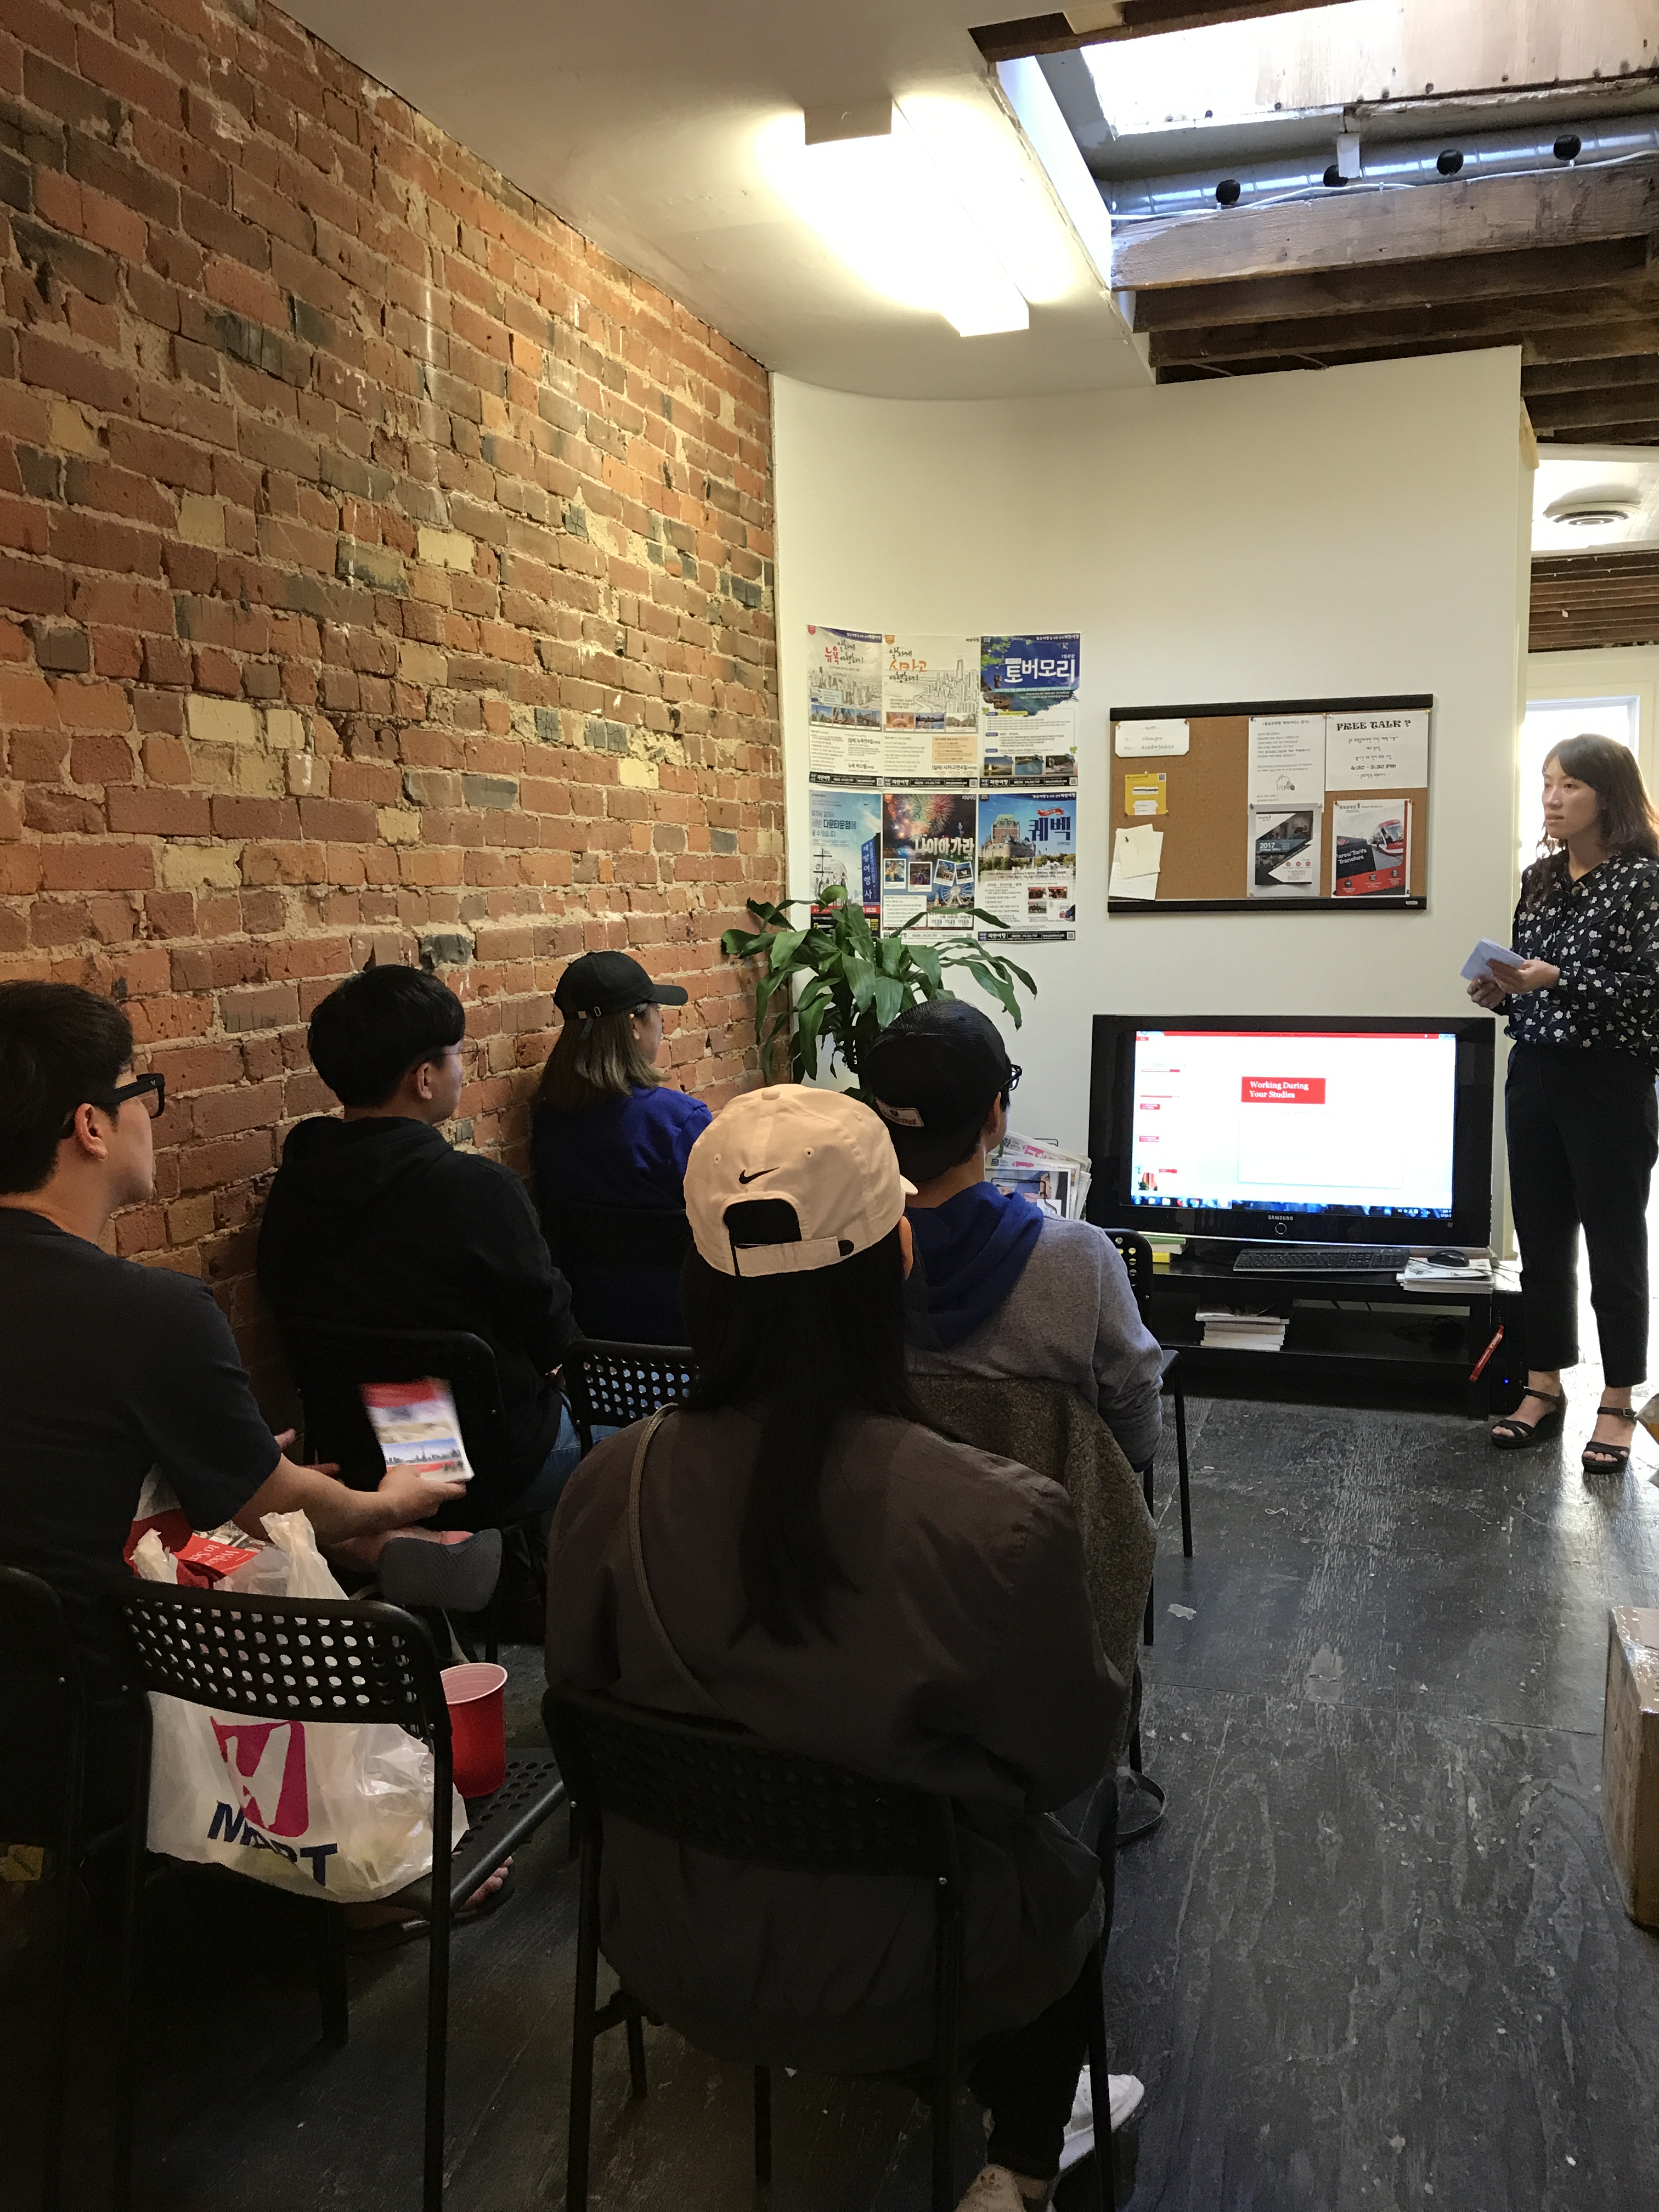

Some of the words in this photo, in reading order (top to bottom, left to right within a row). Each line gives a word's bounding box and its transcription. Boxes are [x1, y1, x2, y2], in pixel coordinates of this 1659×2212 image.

[825, 646, 839, 665] 뉴욕
[889, 658, 927, 673] 시카고
[1004, 658, 1075, 684] 토버모리
[1336, 722, 1367, 731] FREE
[1370, 720, 1402, 729] TALK
[1404, 719, 1412, 727] ?
[1028, 816, 1071, 842] 퀘벡
[915, 837, 974, 856] 나이아가라
[1338, 855, 1364, 865] Transfers
[863, 844, 873, 899] 세방여행사
[1250, 1081, 1282, 1090] Working
[1283, 1081, 1309, 1091] During
